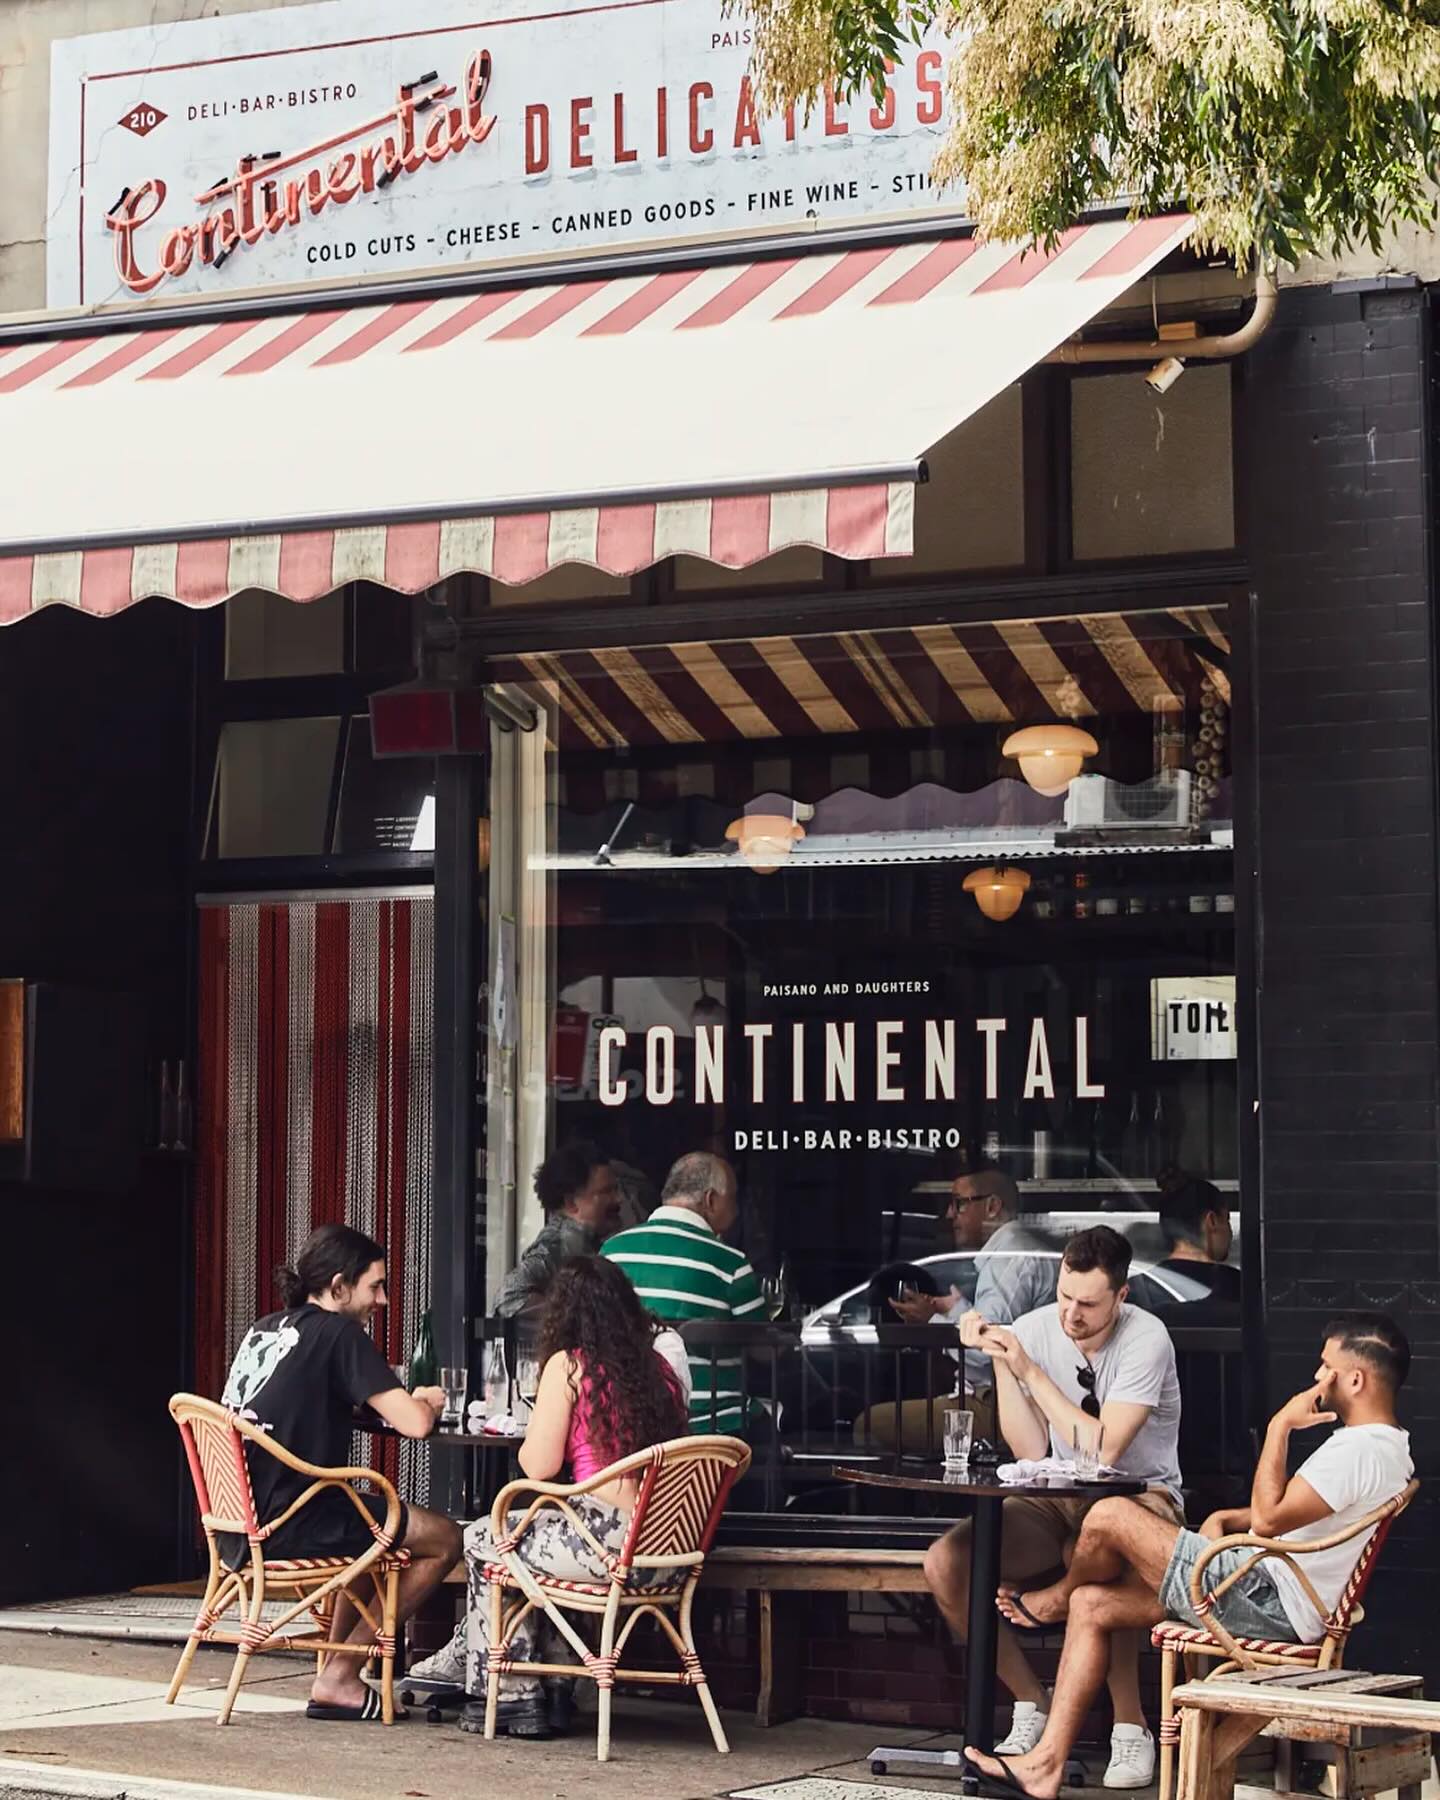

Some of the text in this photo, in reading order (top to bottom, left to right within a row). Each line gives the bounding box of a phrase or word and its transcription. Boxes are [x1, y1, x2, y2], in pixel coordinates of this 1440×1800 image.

[711, 28, 752, 49] PAIS
[129, 112, 157, 129] 210
[105, 48, 944, 293] Continental DELICAESS
[306, 242, 357, 264] COLD
[367, 234, 416, 256] CUTS
[446, 222, 521, 247] CHEESE
[552, 209, 633, 234] CANNED
[644, 198, 715, 223] GOODS
[748, 189, 794, 212] FINE
[806, 181, 859, 204] WINE
[763, 981, 930, 997] PAISANO AND DAUGHTERS
[599, 1016, 1105, 1106] CONTINENTAL
